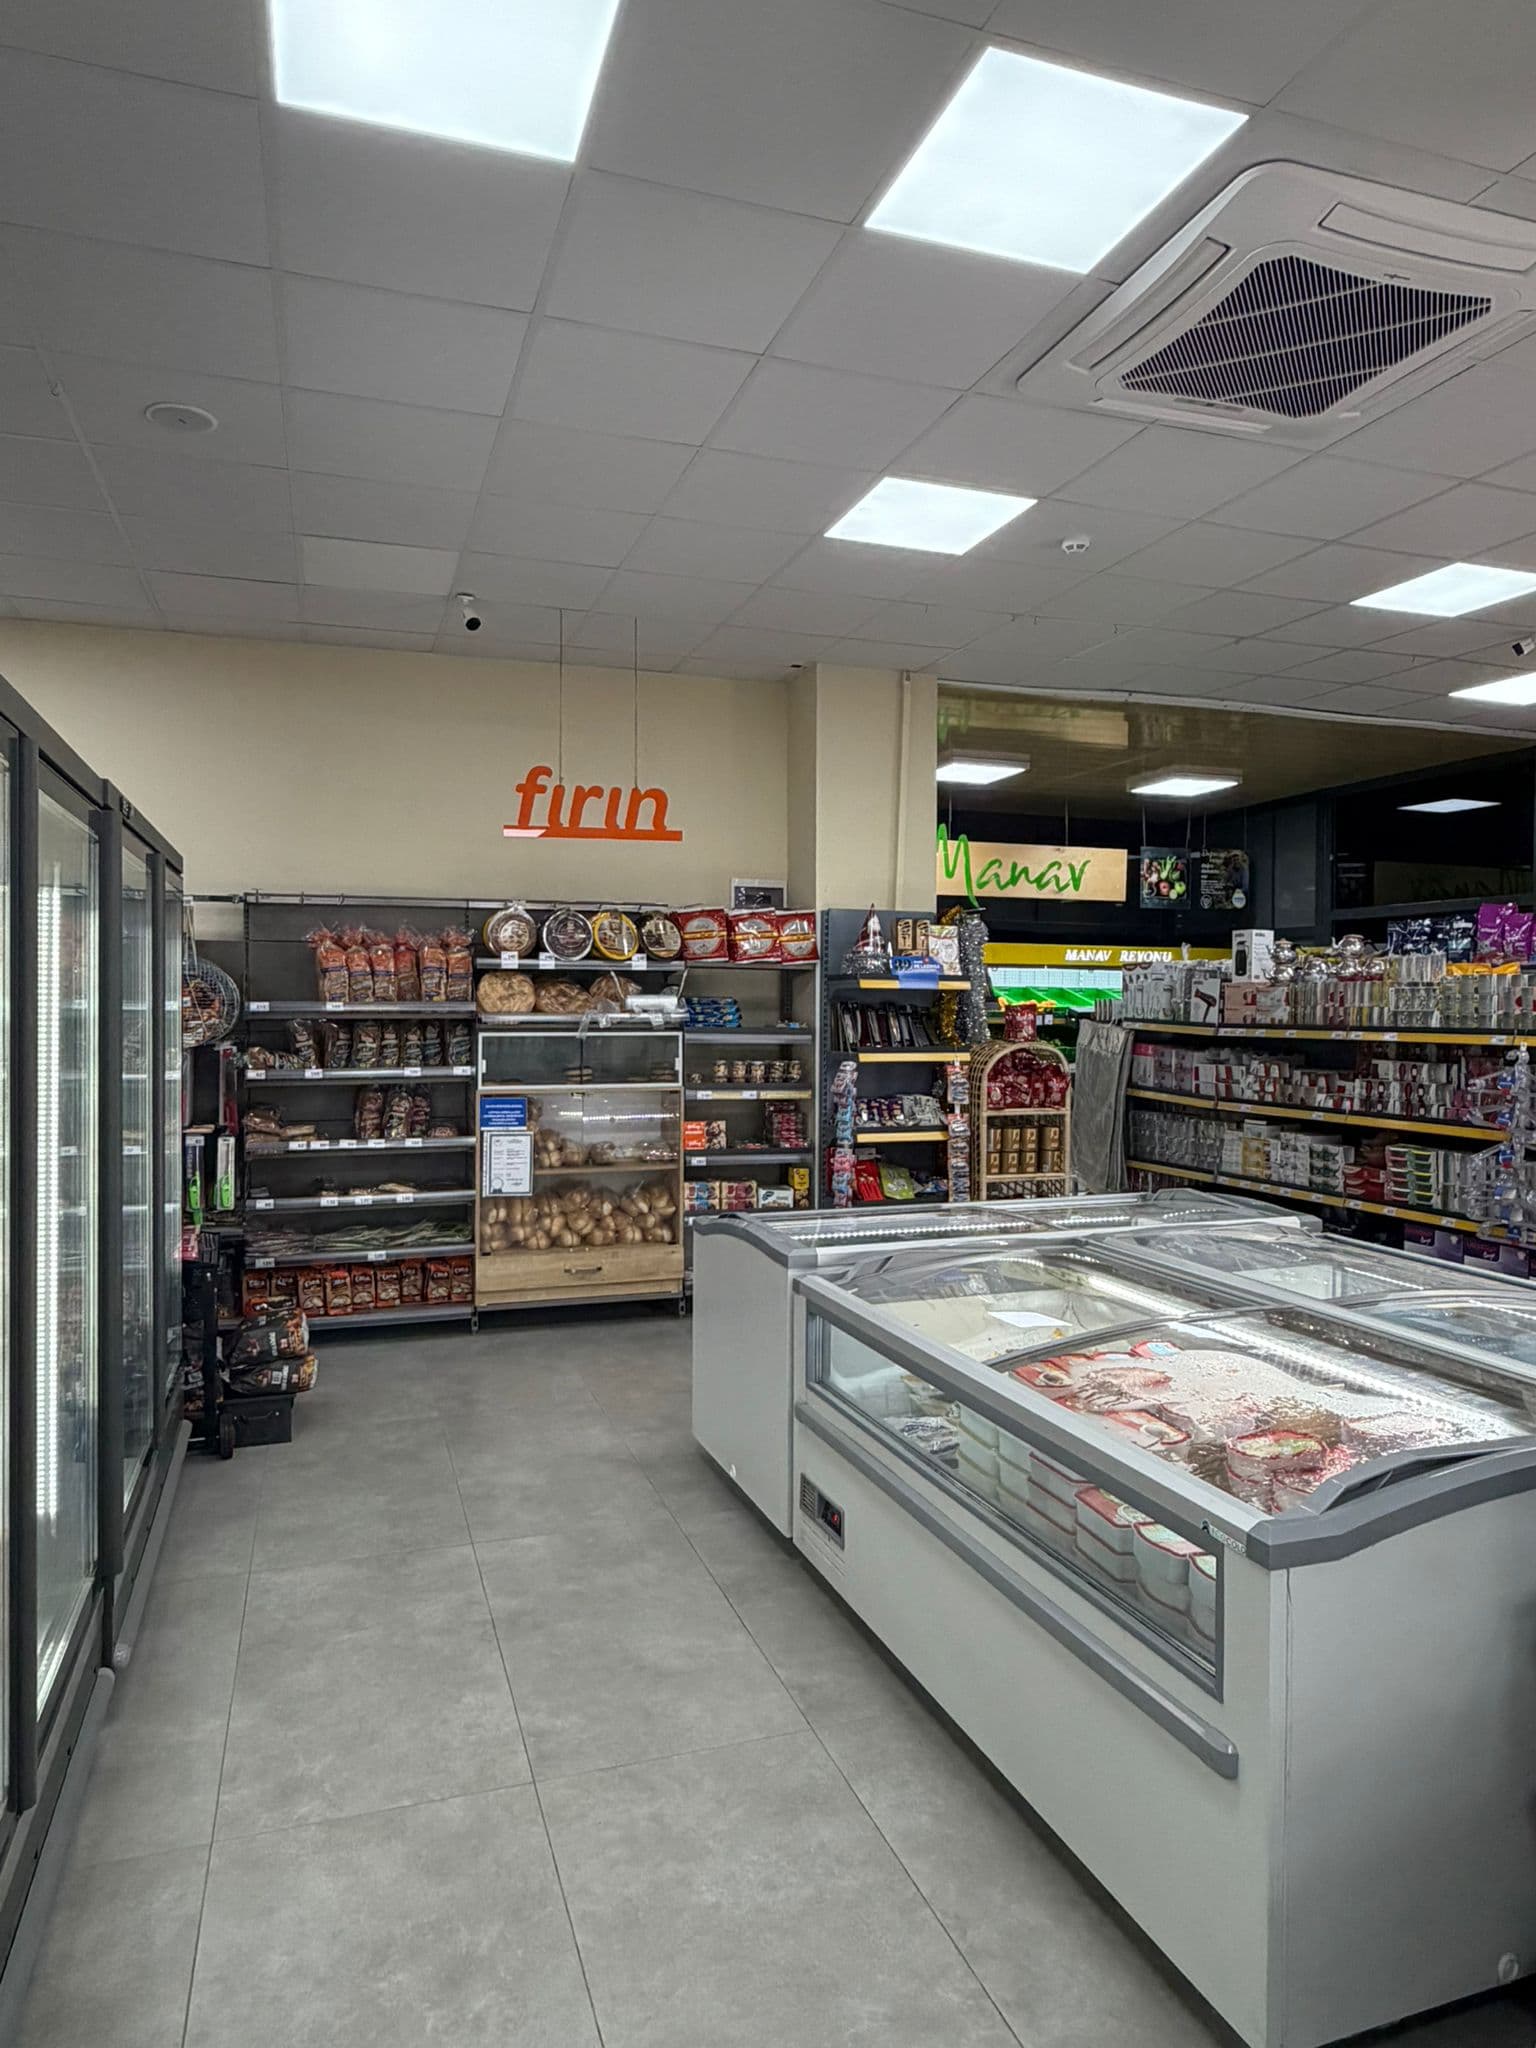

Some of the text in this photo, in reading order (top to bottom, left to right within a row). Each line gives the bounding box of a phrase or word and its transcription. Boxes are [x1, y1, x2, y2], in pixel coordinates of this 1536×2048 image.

[515, 765, 669, 831] fırın
[937, 823, 1092, 908] Manav
[1065, 949, 1173, 963] MANAV REYONU
